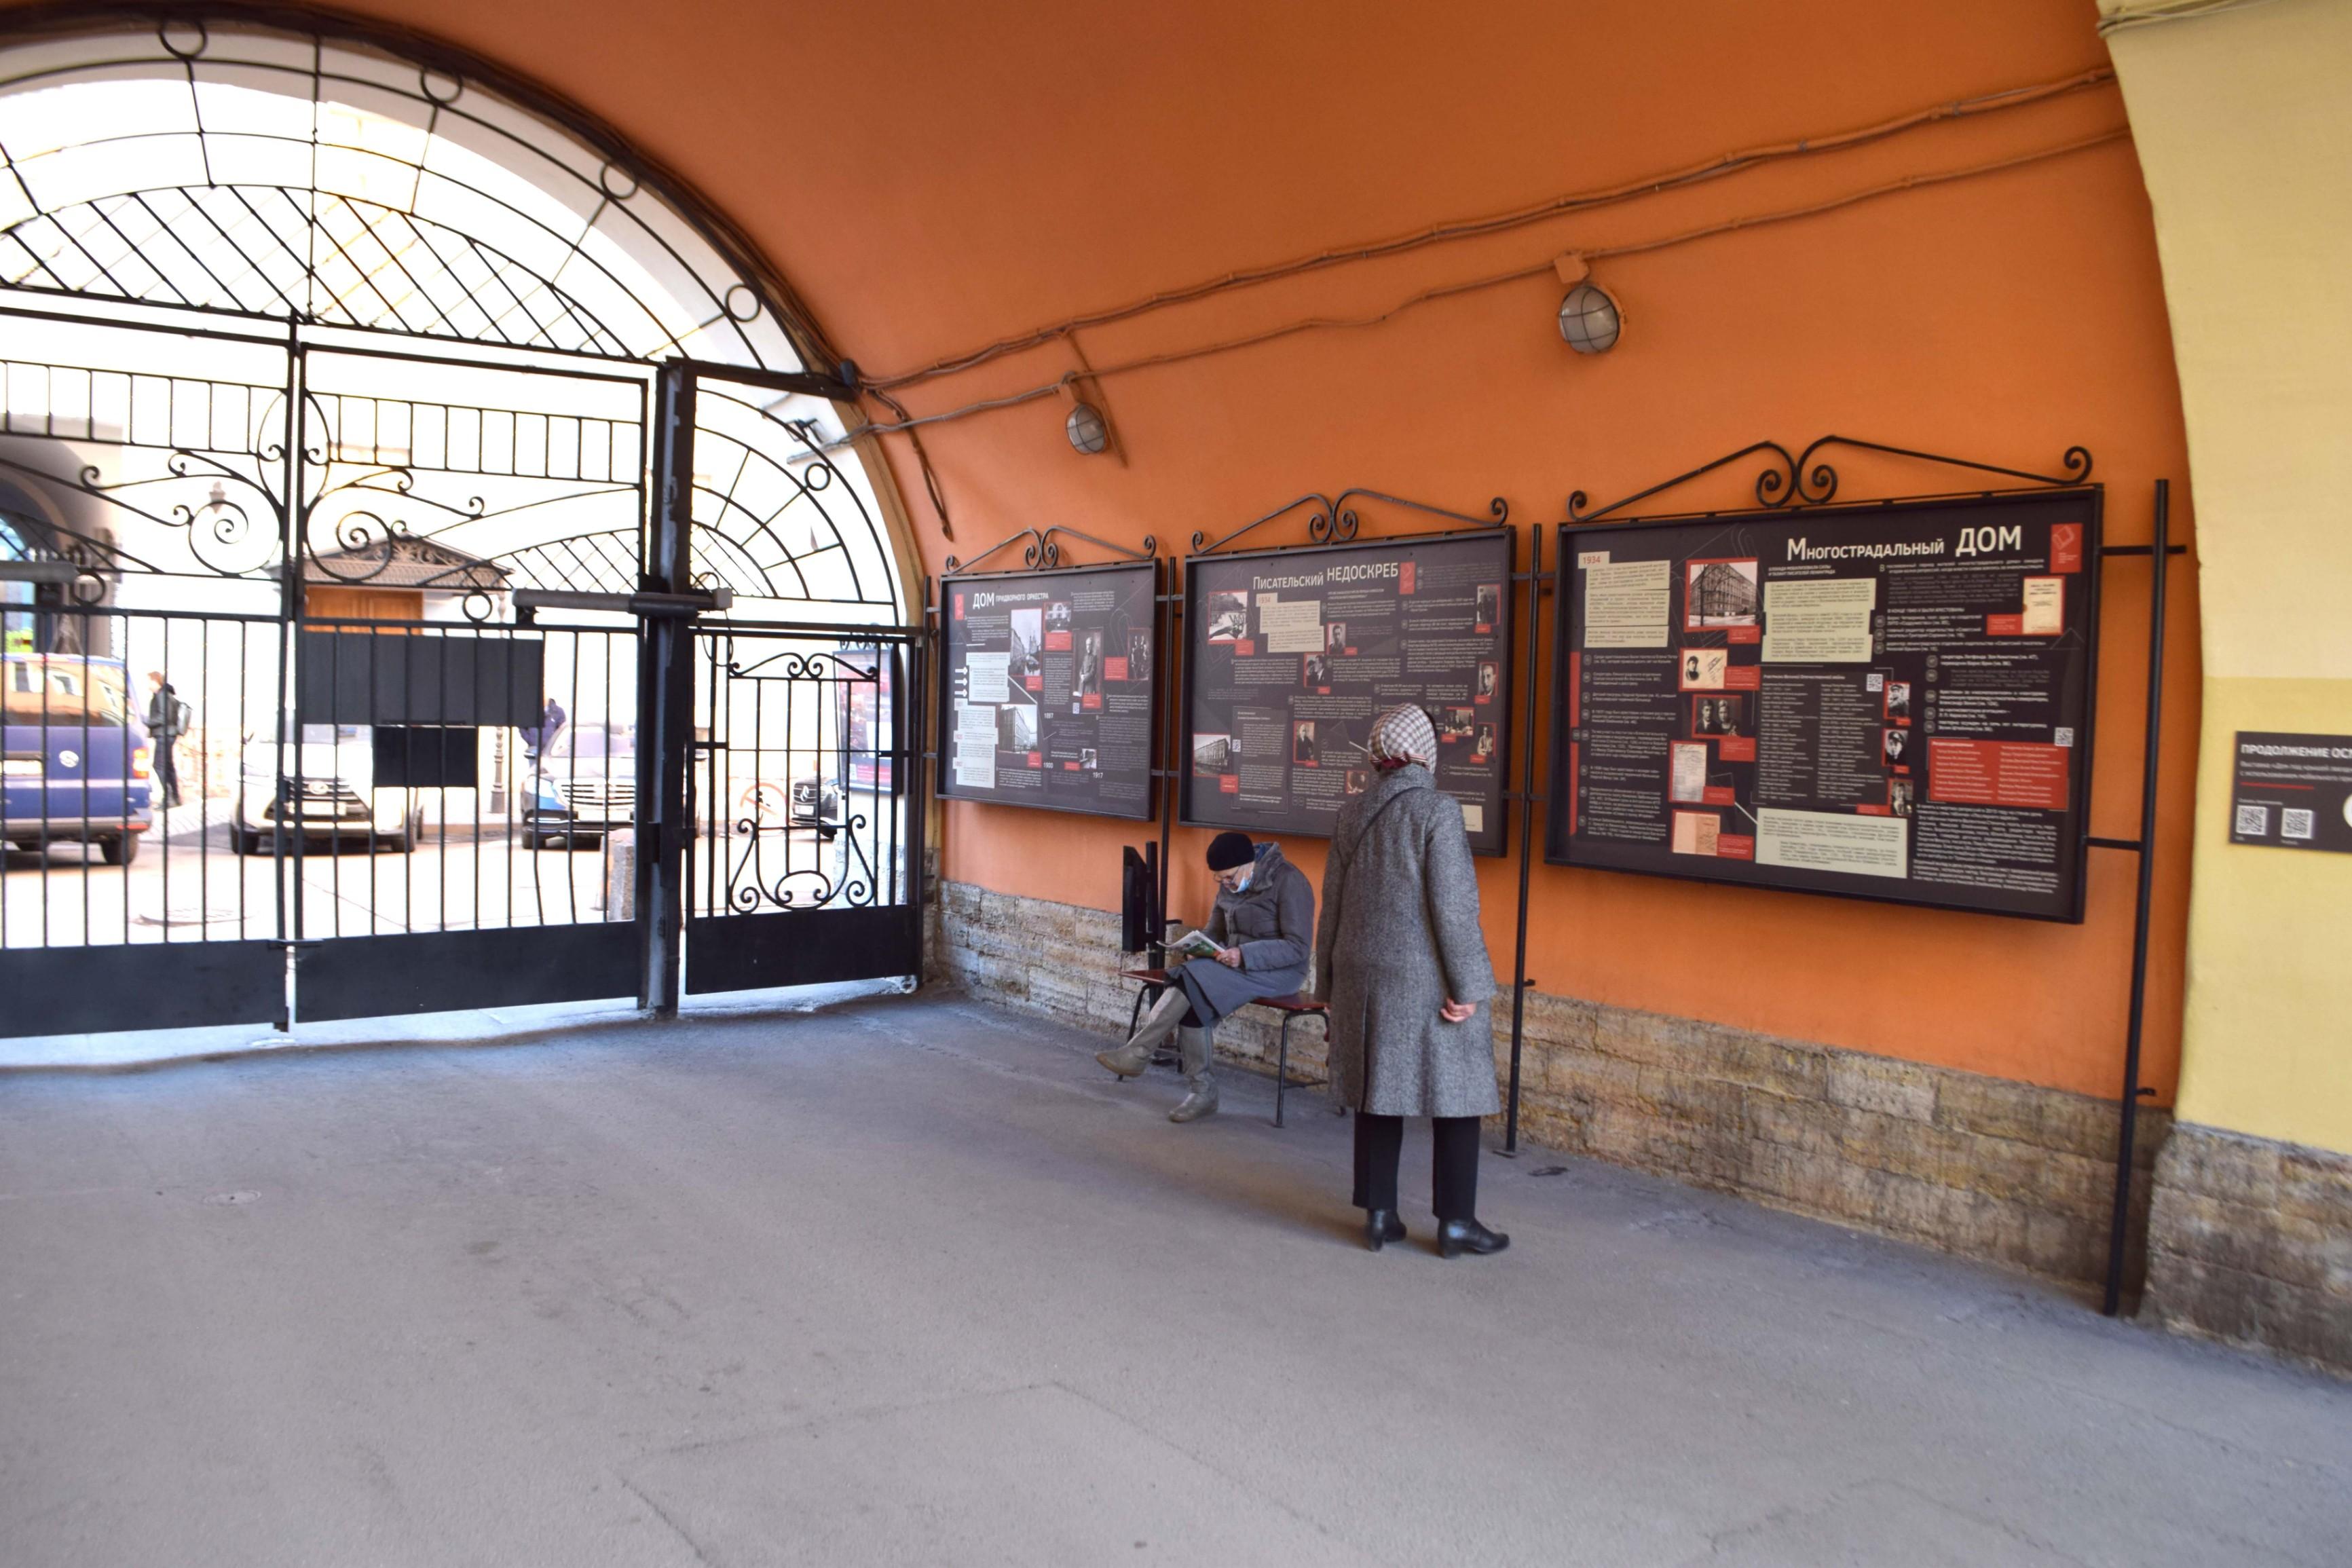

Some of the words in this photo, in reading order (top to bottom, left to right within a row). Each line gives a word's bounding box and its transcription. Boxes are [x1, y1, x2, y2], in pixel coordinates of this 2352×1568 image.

[1955, 525, 2021, 558] ДОМ
[1583, 556, 1601, 565] 1934
[1327, 563, 1398, 582] НЕДОСКРЕБ
[973, 592, 994, 610] ДОМ
[2241, 744, 2330, 758] ПРОДОЛЖЕНИЕ
